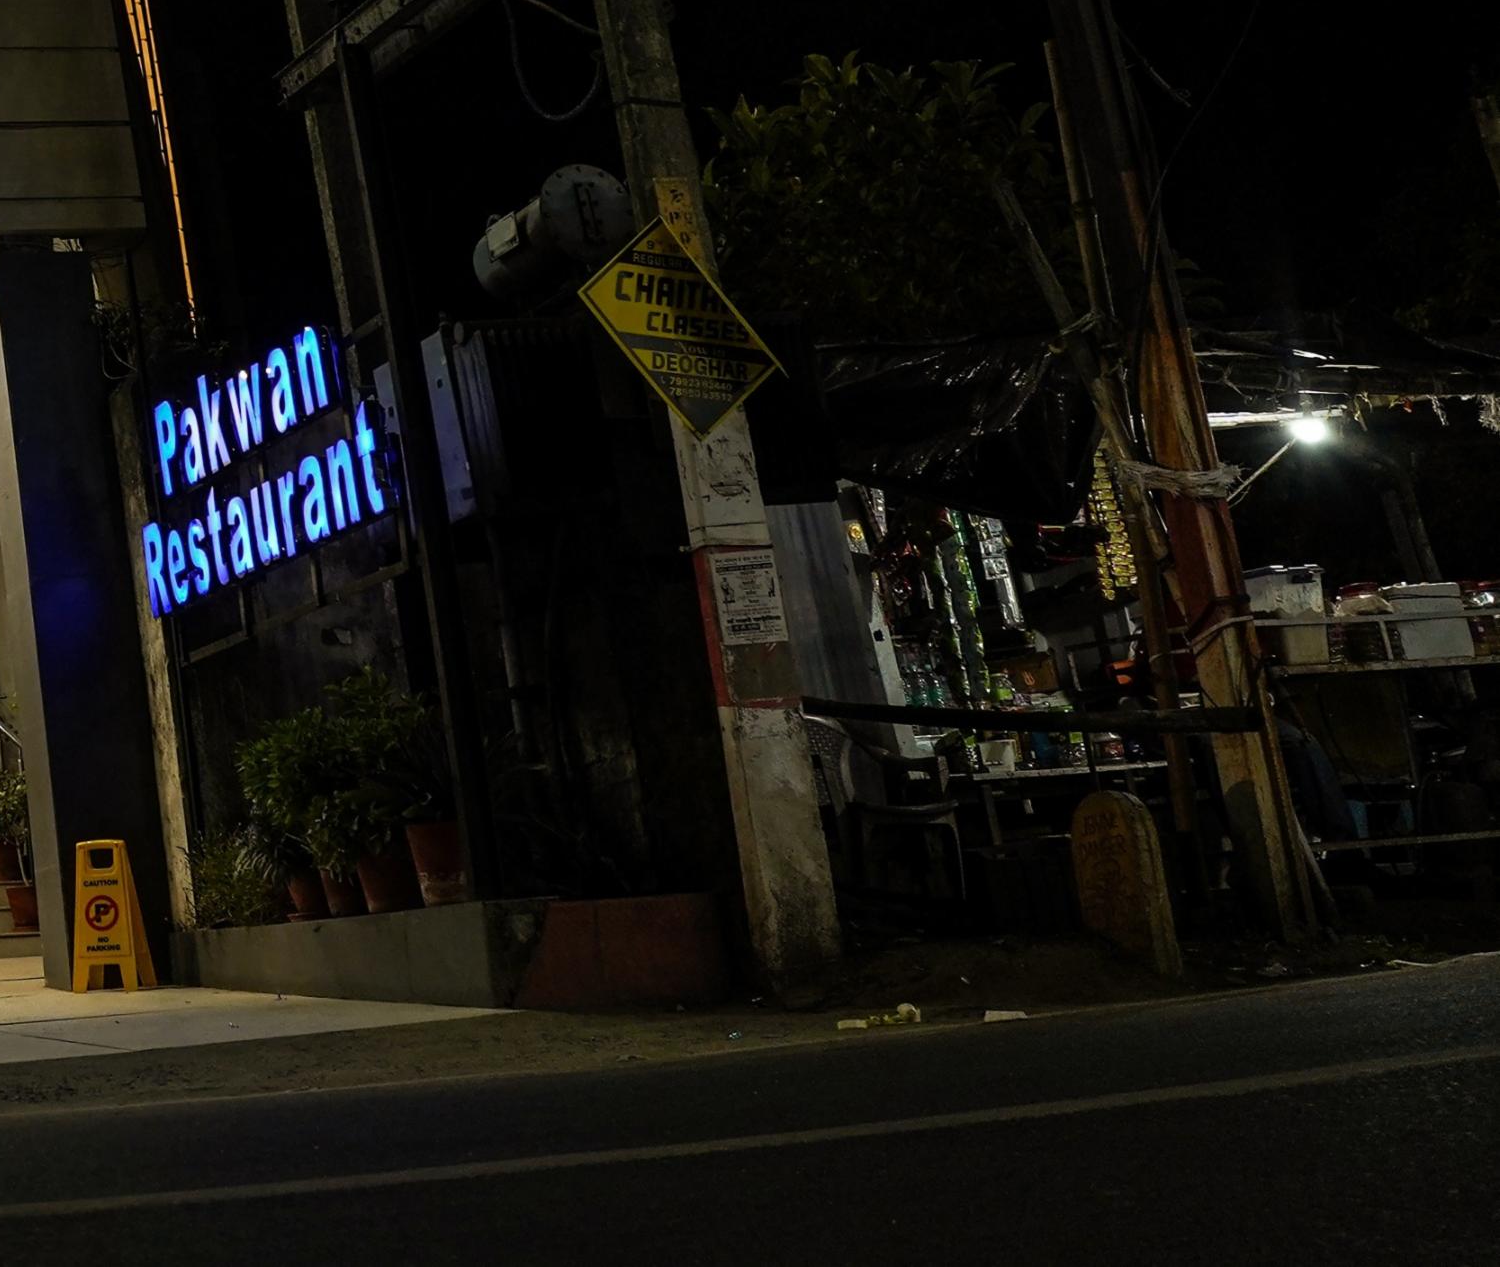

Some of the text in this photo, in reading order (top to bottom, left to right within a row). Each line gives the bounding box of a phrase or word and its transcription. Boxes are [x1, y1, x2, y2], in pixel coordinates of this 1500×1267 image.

[647, 311, 750, 342] CLASSES
[652, 352, 748, 381] DEOGHAR
[153, 325, 329, 497] Pakwan
[142, 400, 385, 619] Restaurant
[83, 879, 118, 887] CAUTION
[98, 936, 109, 944] NO
